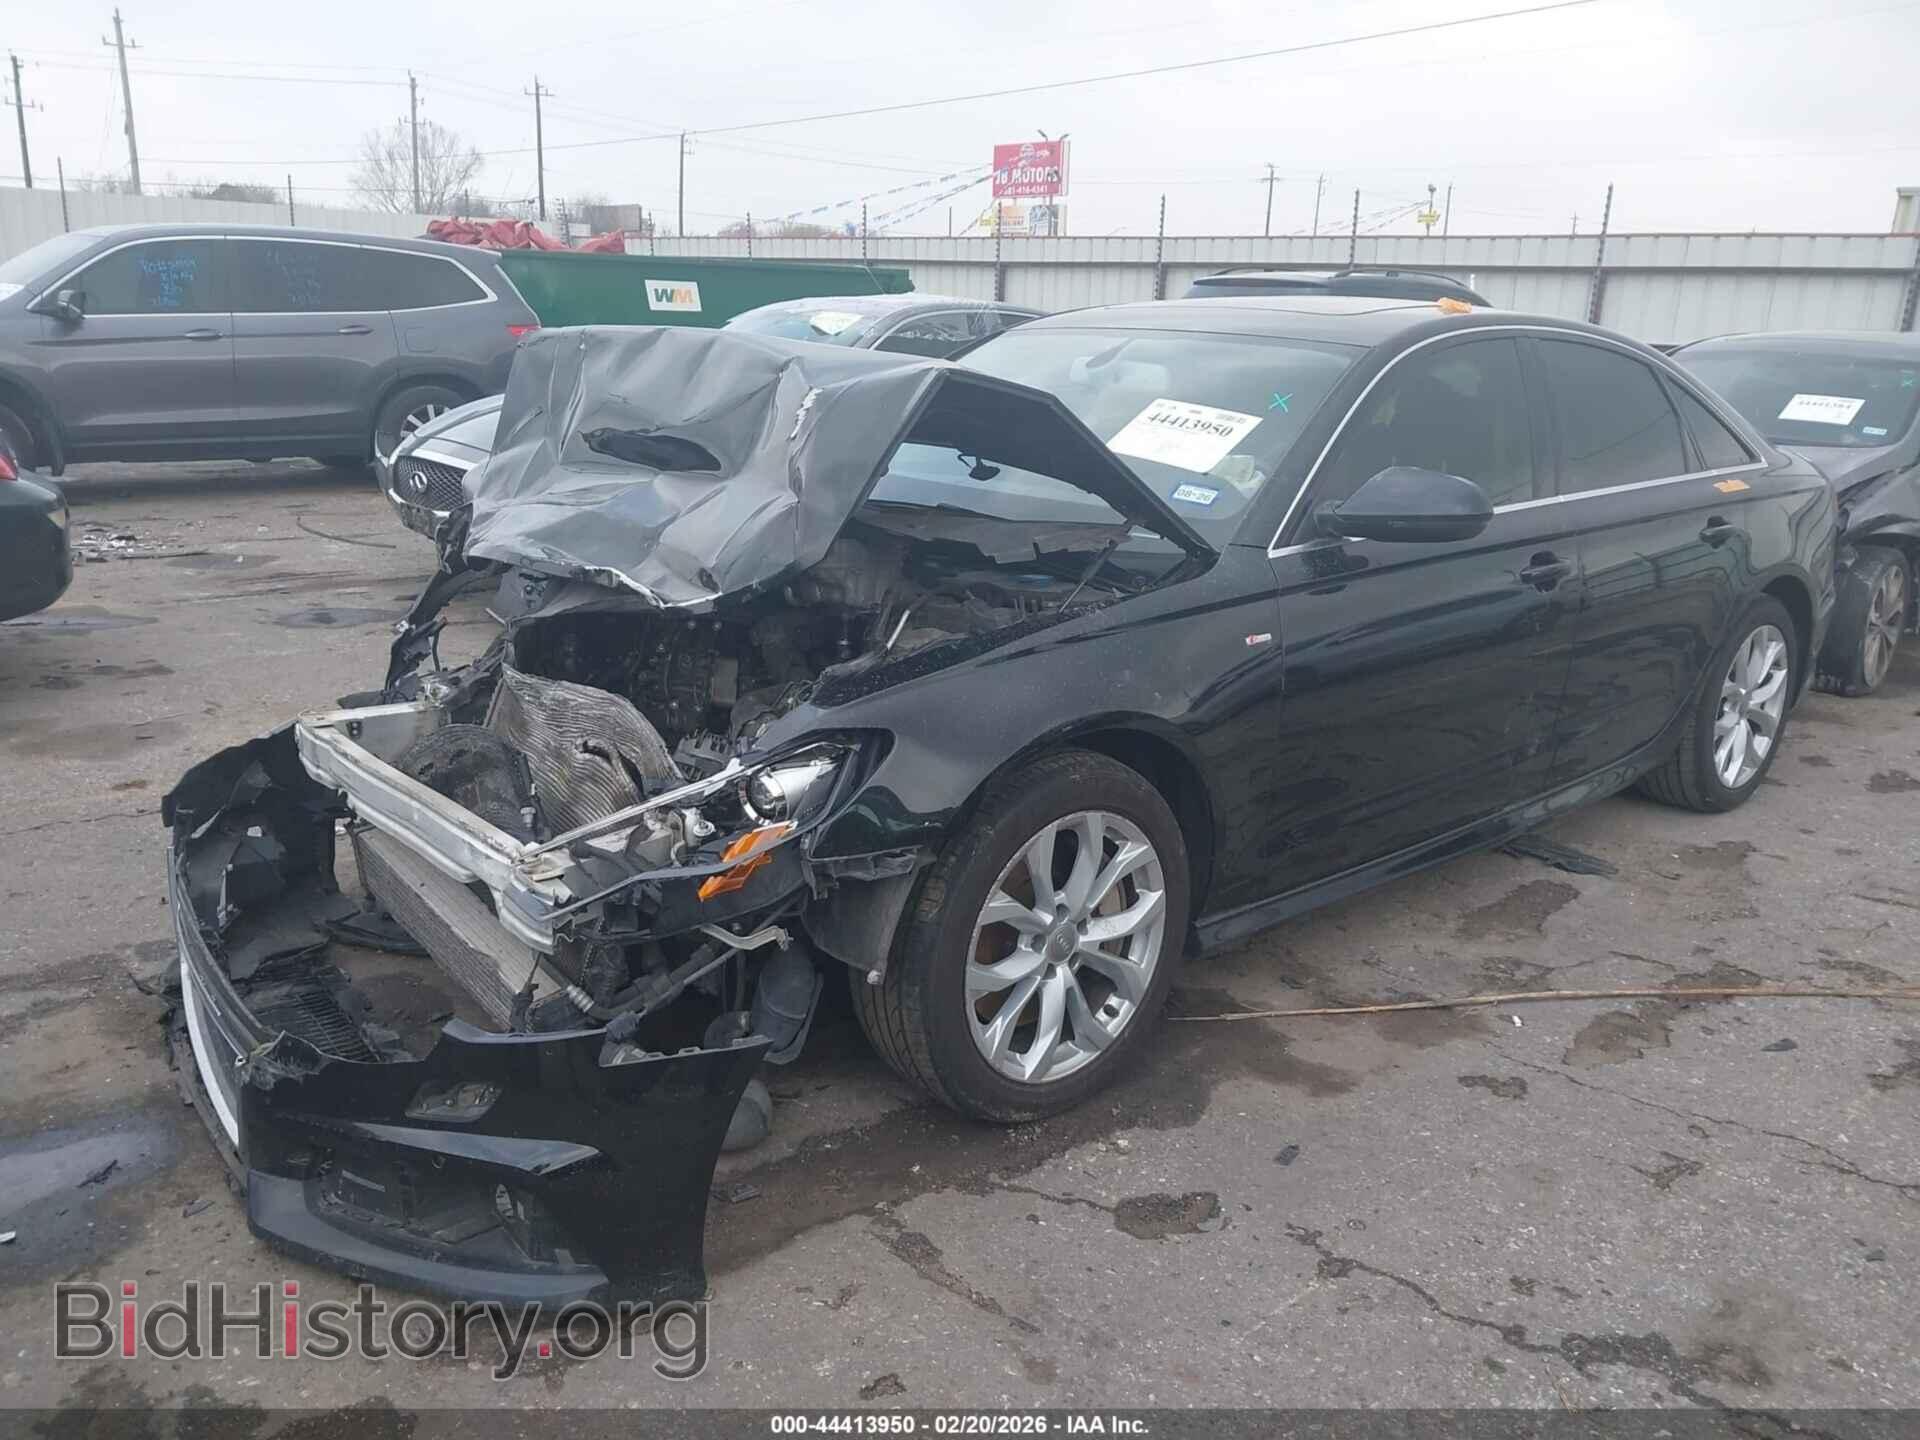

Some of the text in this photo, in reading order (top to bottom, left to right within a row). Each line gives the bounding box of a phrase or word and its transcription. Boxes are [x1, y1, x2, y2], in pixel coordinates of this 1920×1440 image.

[1011, 166, 1059, 183] MOTORS
[654, 287, 693, 304] WM
[1147, 411, 1234, 438] 44413950
[1176, 488, 1213, 502] 08-26
